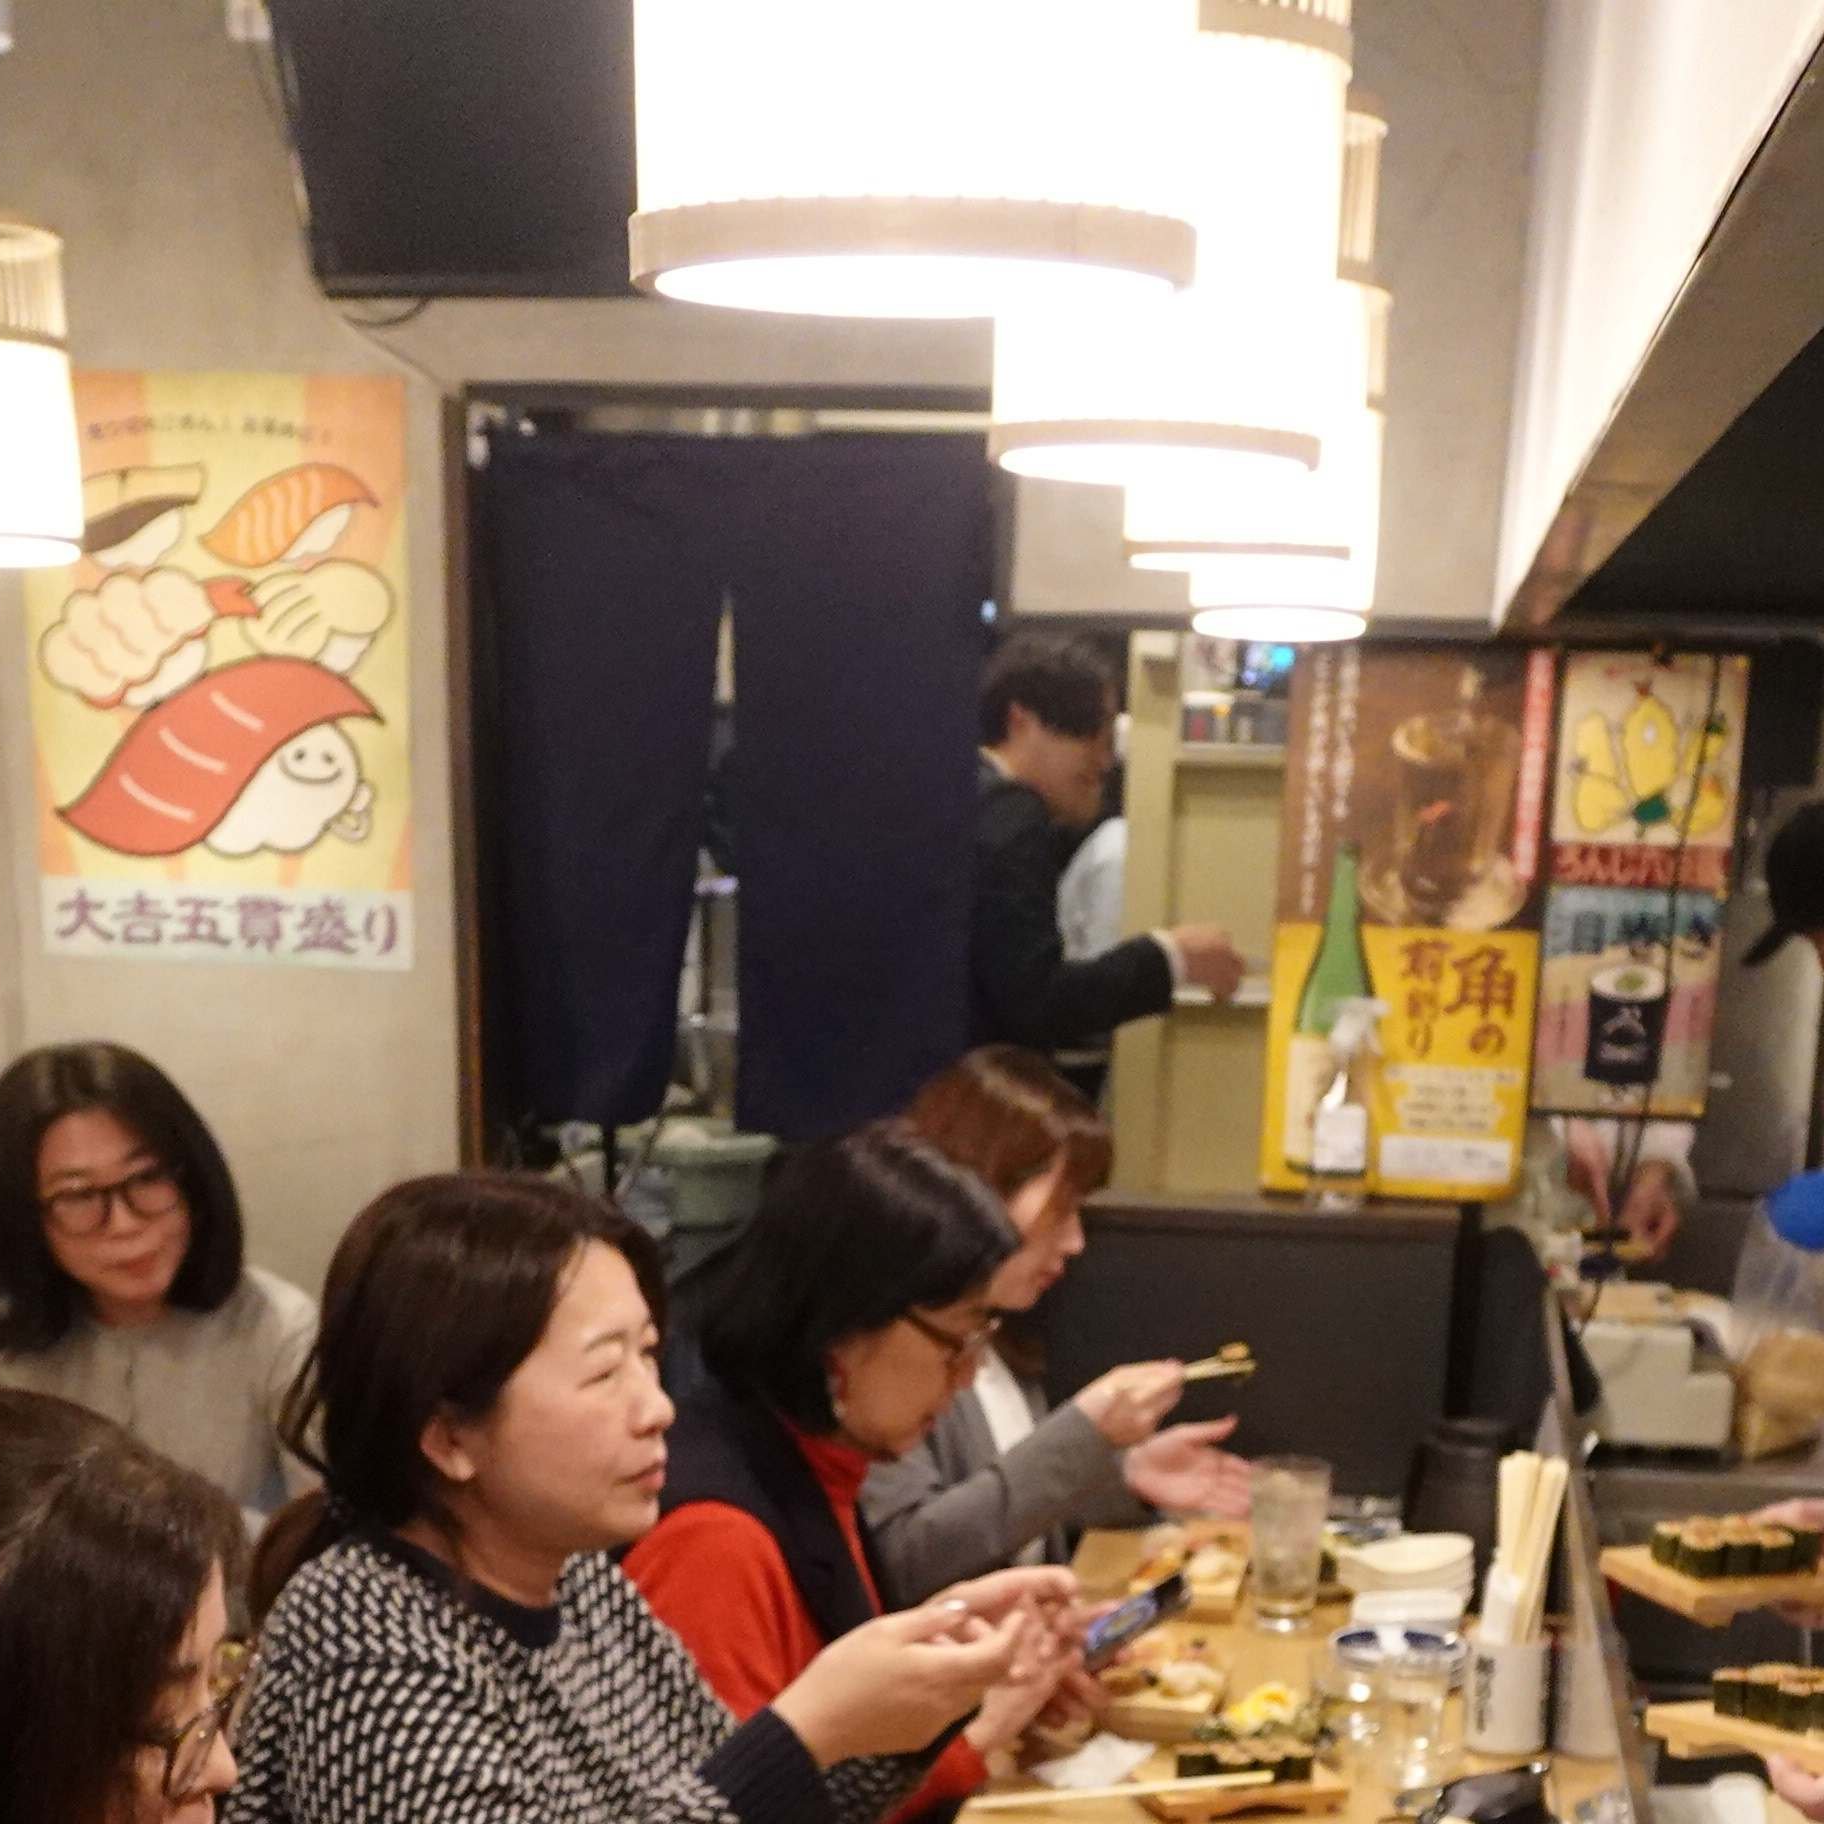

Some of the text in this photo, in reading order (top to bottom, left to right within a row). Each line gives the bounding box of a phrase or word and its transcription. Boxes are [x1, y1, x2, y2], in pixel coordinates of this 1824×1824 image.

[54, 888, 399, 956] 大吉五貫盛り
